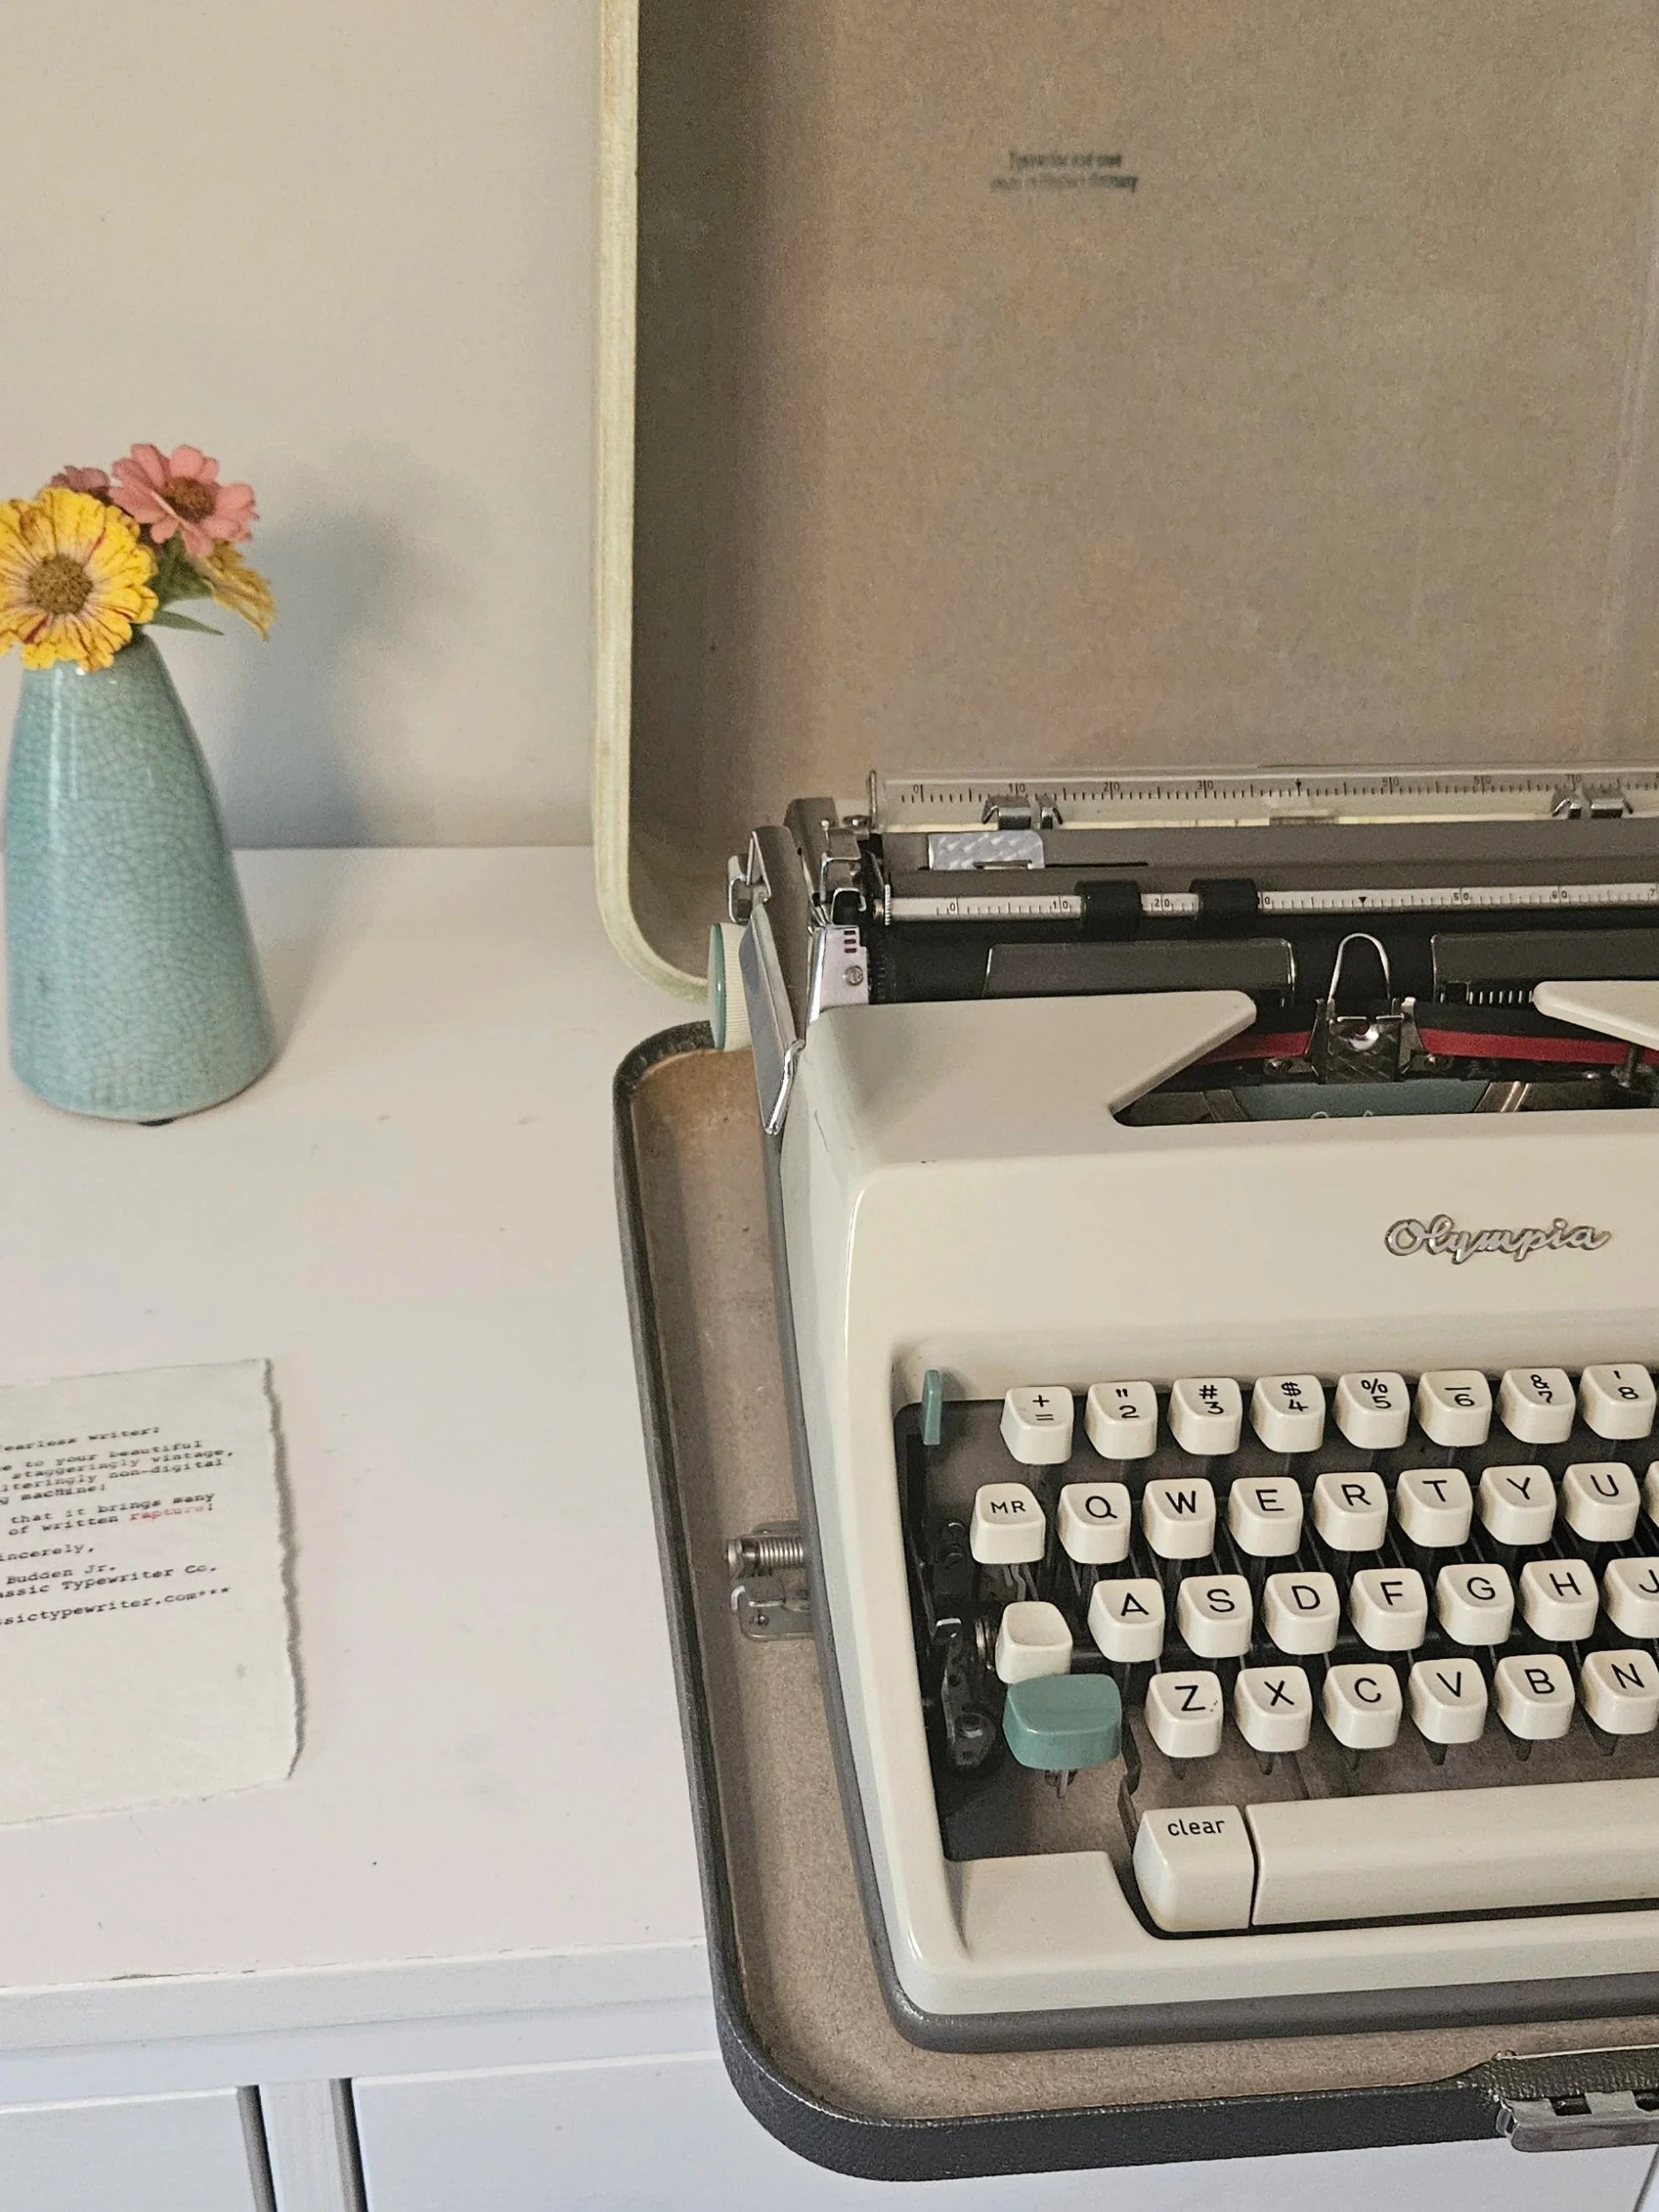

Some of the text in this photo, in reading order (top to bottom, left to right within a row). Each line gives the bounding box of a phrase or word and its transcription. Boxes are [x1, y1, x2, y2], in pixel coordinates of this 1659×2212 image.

[1384, 1214, 1612, 1265] Olympia
[1199, 1384, 1218, 1399] #
[1281, 1382, 1301, 1396] $
[1361, 1378, 1388, 1394] %
[1531, 1374, 1550, 1389] &
[1618, 1386, 1639, 1400] 8
[1204, 1402, 1224, 1414] 3
[1288, 1399, 1308, 1412] 4
[1372, 1396, 1392, 1409] 5
[1455, 1394, 1475, 1407] 6
[1538, 1390, 1553, 1404] 7
[1119, 1405, 1139, 1418] 2
[0, 1427, 159, 1452] earless writer:
[12, 1449, 234, 1480] staggeringly vintage,
[56, 1454, 98, 1466] your
[109, 1440, 202, 1457] beautiful
[109, 1458, 223, 1479] non-digital
[1341, 1484, 1371, 1506] R
[1422, 1479, 1447, 1502] T
[1506, 1477, 1530, 1500] Y
[1590, 1474, 1619, 1497] U
[11, 1512, 53, 1524] that
[98, 1500, 161, 1514] brings
[173, 1493, 215, 1503] many
[991, 1501, 1026, 1514] MR
[1085, 1496, 1118, 1518] Q
[1165, 1491, 1196, 1514] W
[1256, 1489, 1285, 1511] E
[9, 1526, 29, 1536] of
[41, 1515, 119, 1531] written
[6, 1564, 116, 1585] Budden Jr.
[61, 1569, 174, 1591] Typewriter
[184, 1565, 216, 1574] Co.
[1549, 1572, 1581, 1596] H
[1291, 1585, 1321, 1609] D
[1380, 1581, 1403, 1605] F
[1467, 1576, 1496, 1600] G
[0, 1586, 230, 1625] sictypewriter.com
[1121, 1592, 1149, 1616] A
[1206, 1589, 1235, 1613] S
[1436, 1671, 1461, 1698] V
[1524, 1668, 1555, 1694] B
[1611, 1663, 1644, 1689] N
[1174, 1684, 1206, 1712] Z
[1263, 1680, 1295, 1706] X
[1354, 1677, 1382, 1702] C
[1167, 1818, 1225, 1836] clear
